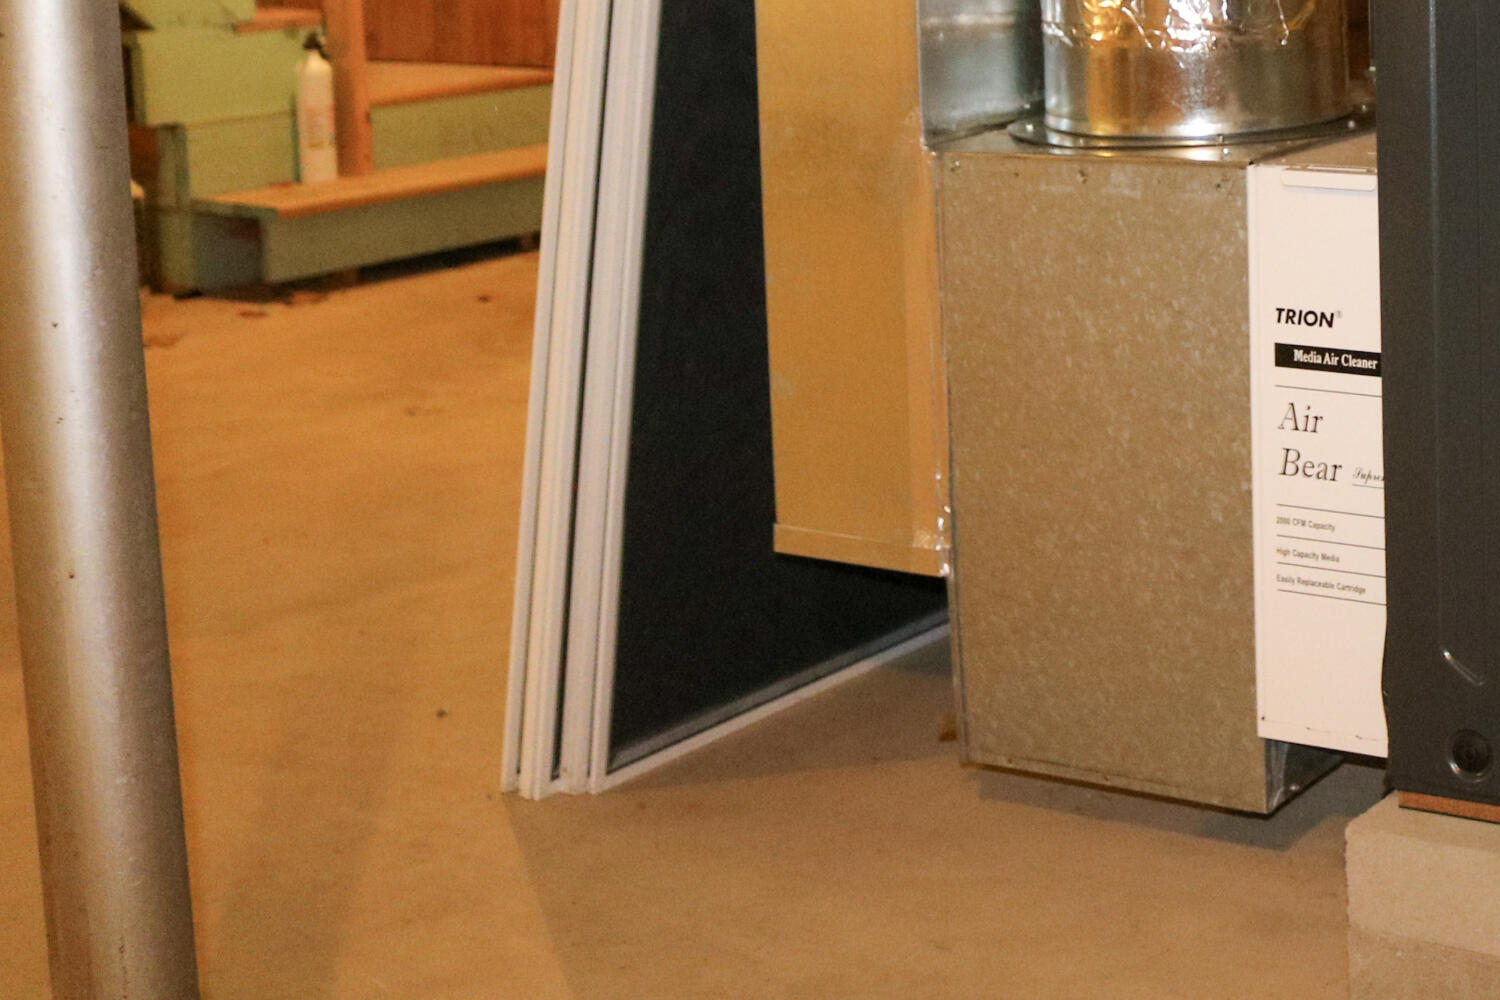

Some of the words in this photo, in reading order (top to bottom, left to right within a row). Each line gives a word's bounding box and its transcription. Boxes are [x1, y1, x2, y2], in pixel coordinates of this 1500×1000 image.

[1293, 348, 1322, 364] Media
[1323, 352, 1339, 366] Air
[1341, 353, 1379, 370] Cleaner
[1277, 401, 1324, 433] Air
[1278, 447, 1343, 481] Bear
[1292, 518, 1307, 527] CFM
[1308, 520, 1336, 532] Capacity
[1292, 549, 1320, 561] Capacity
[1321, 553, 1340, 563] Media
[1276, 573, 1296, 586] Easily
[1297, 576, 1335, 589] Replaceable
[1336, 582, 1367, 596] Cartridge
